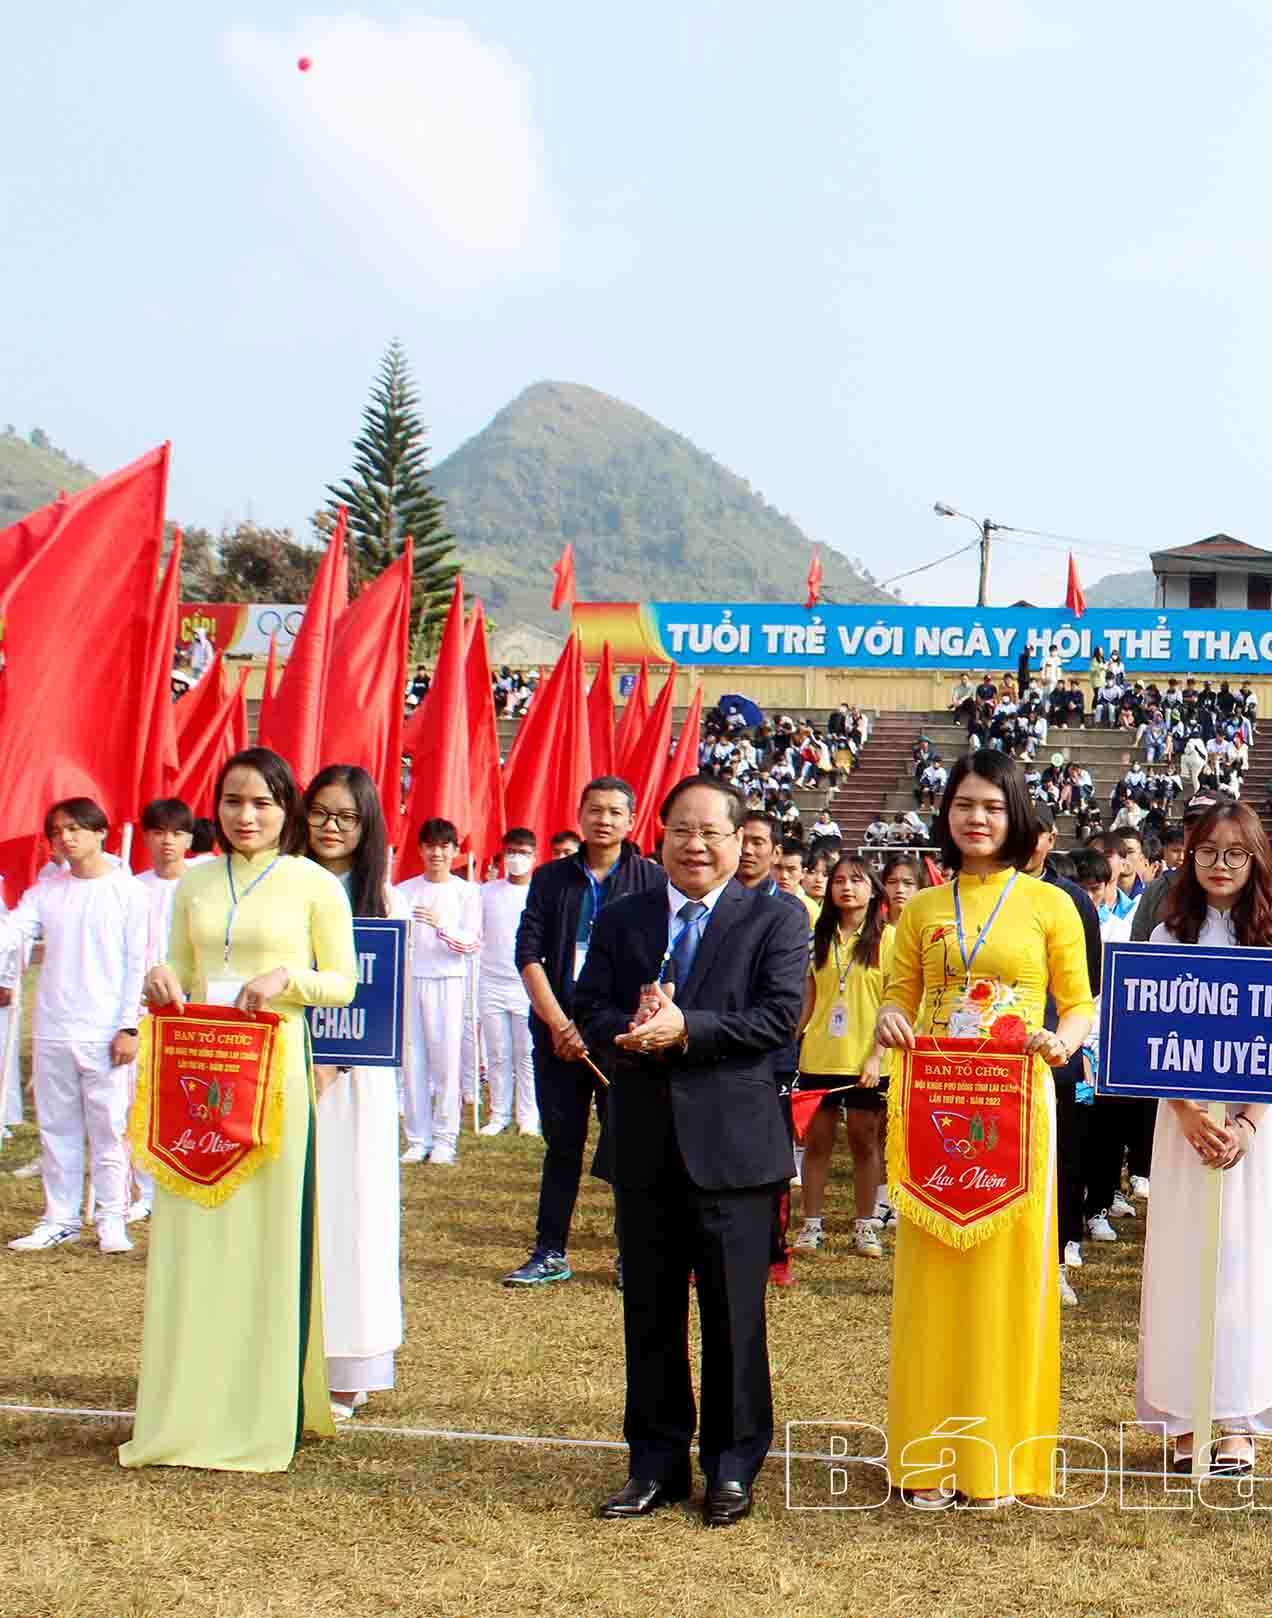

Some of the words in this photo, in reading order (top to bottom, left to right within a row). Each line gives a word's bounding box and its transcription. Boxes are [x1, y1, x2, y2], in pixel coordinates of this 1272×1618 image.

[667, 611, 750, 655] TUỔI
[761, 617, 827, 655] TRẺ
[838, 620, 904, 656] VỚI
[915, 622, 1017, 658] NGÀY
[1027, 624, 1092, 663] HỘI
[1103, 616, 1172, 659] THỂ
[1123, 972, 1239, 1016] TRƯỜNG
[924, 1064, 952, 1075] BAN
[955, 1060, 973, 1076] TỔ
[1147, 1031, 1204, 1073] TÂN
